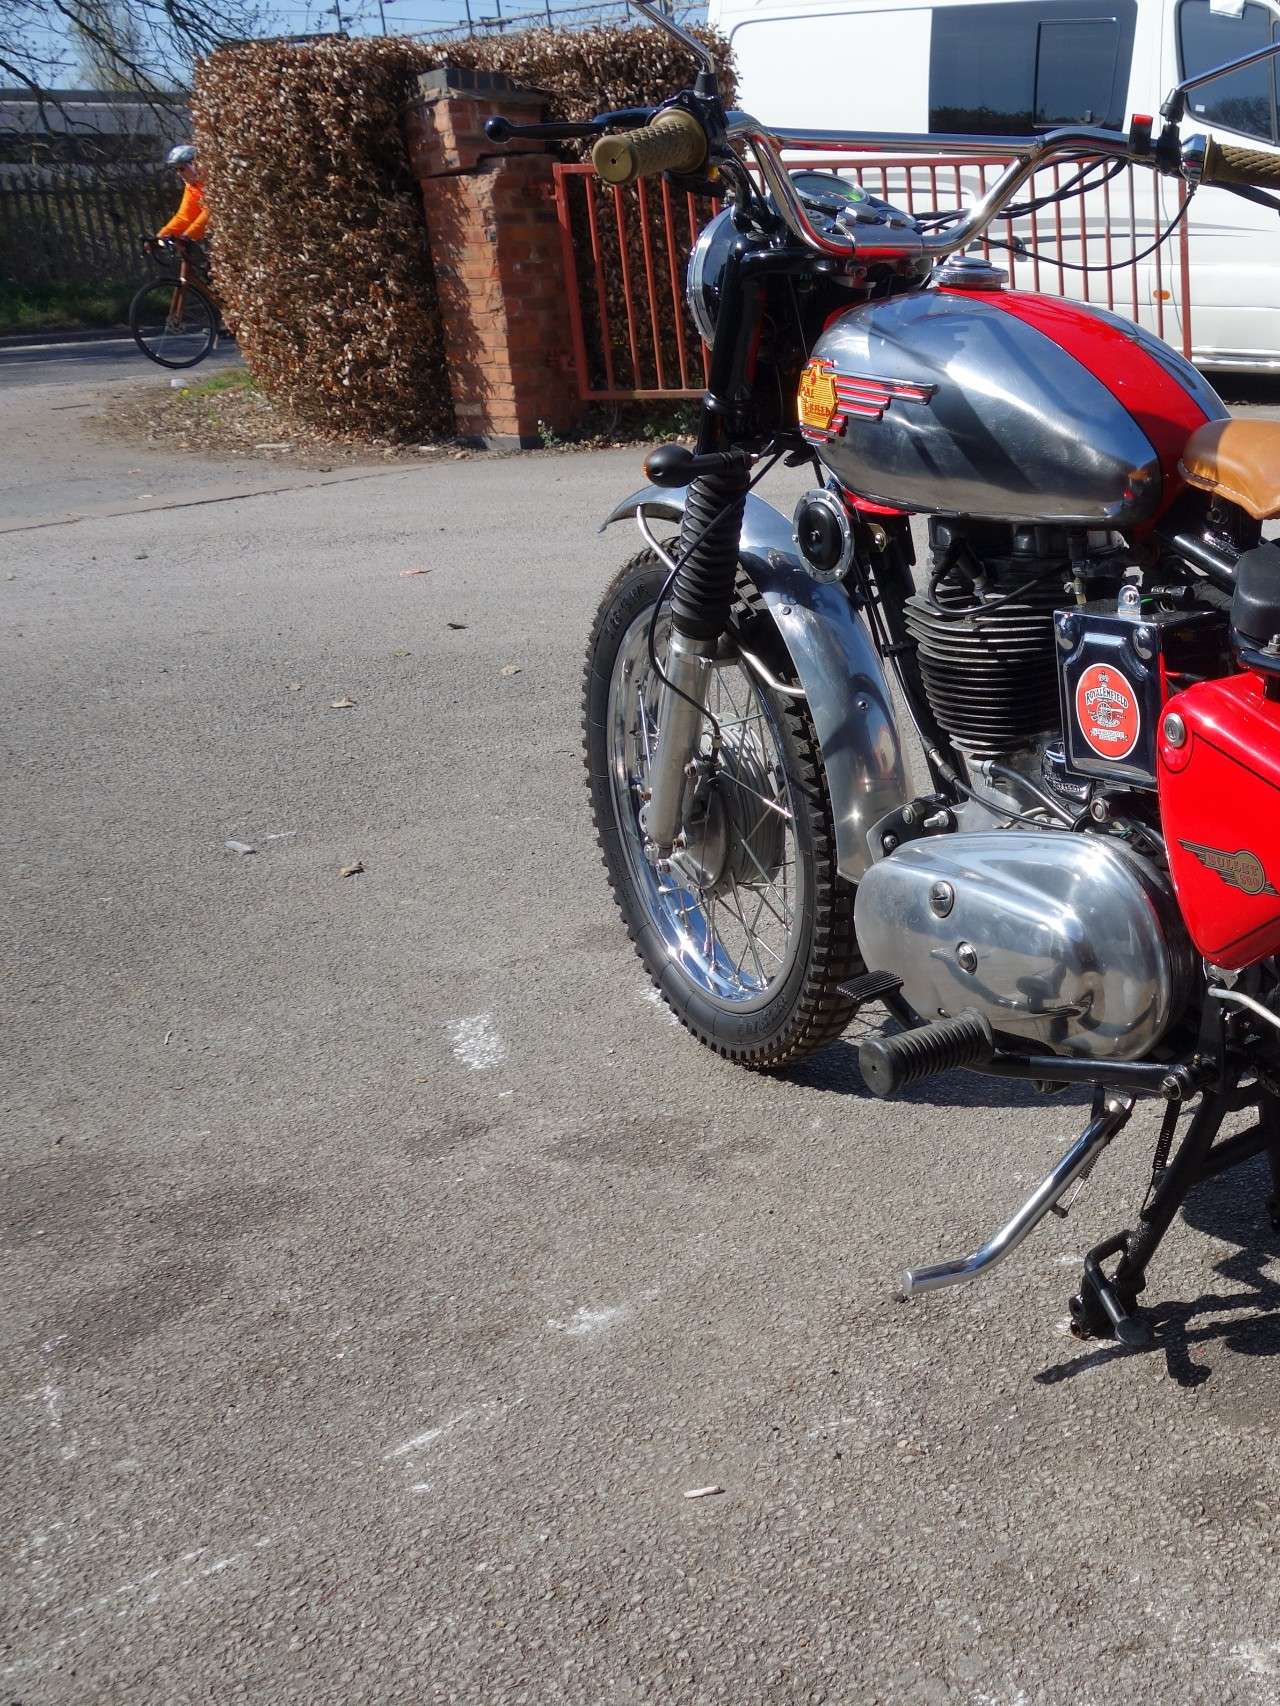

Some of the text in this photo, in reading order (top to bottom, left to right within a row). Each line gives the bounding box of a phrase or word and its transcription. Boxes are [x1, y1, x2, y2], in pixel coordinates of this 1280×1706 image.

[1086, 688, 1128, 708] ROYAL ENFIELD
[1206, 853, 1259, 875] BULLET
